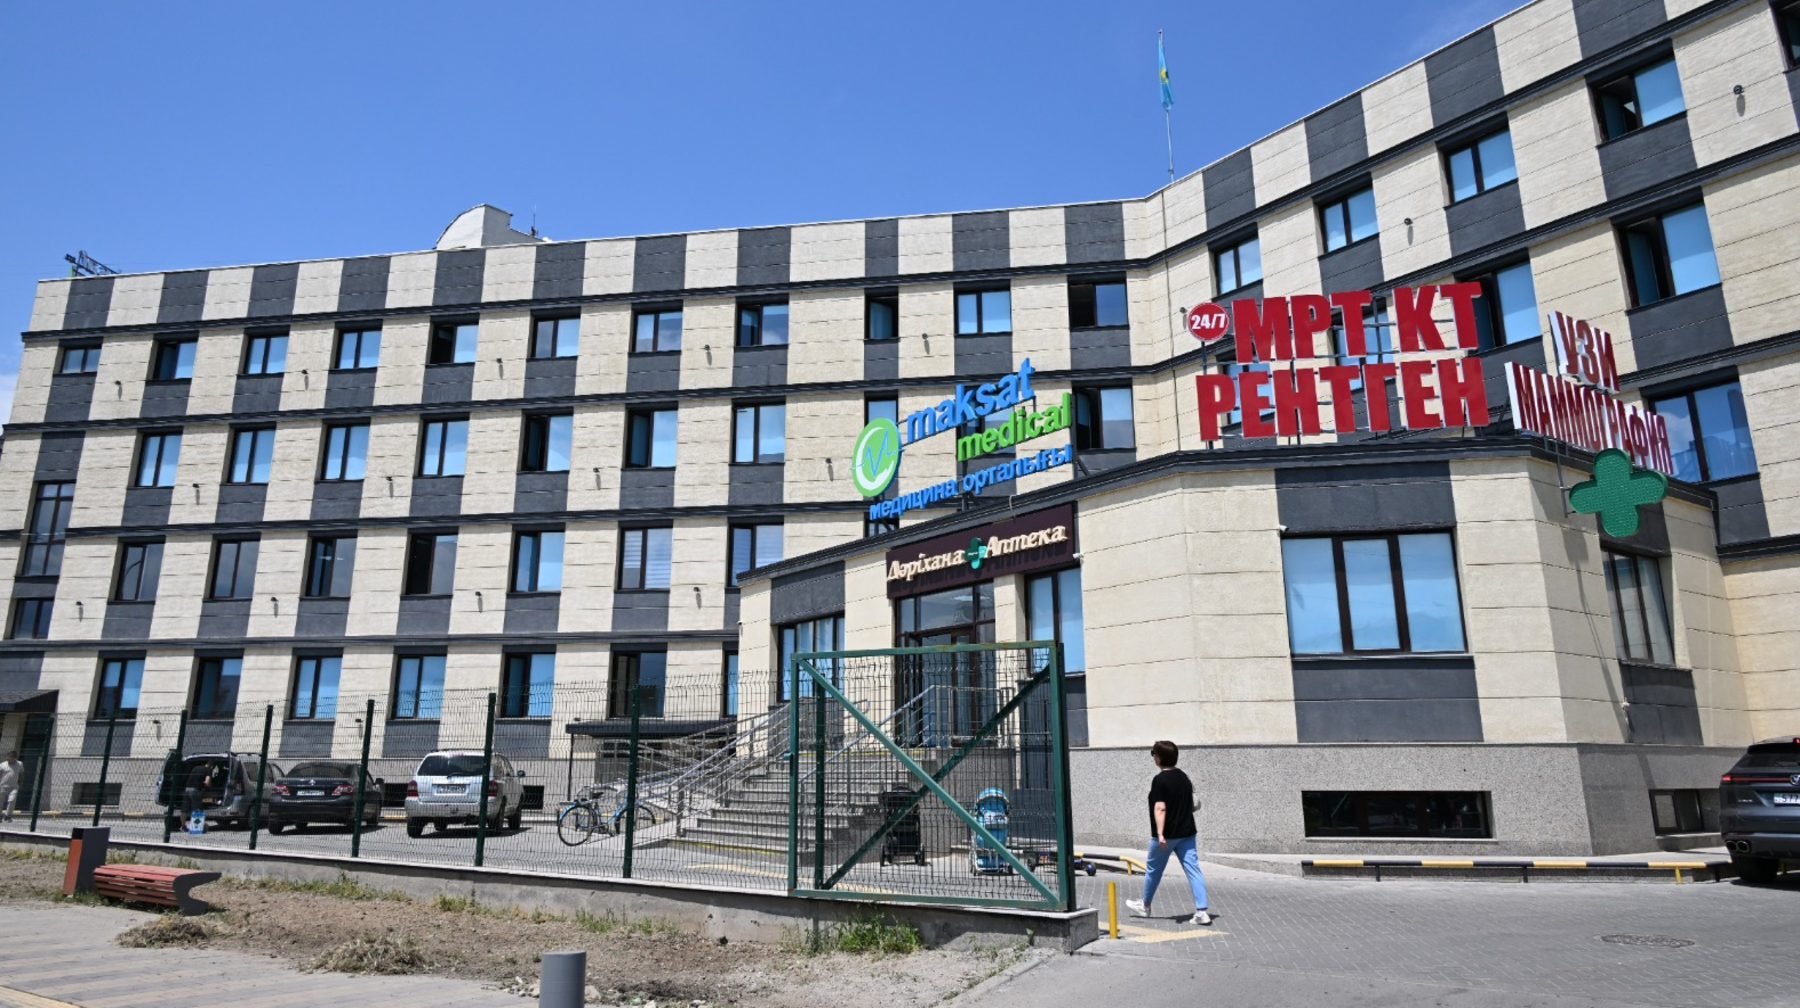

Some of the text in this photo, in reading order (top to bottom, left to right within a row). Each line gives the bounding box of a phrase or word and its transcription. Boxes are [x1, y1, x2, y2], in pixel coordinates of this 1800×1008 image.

[1191, 313, 1226, 330] 24/7
[1232, 282, 1482, 363] МРТ КТ
[1549, 310, 1620, 394] УЗИ
[907, 357, 1035, 443] maksat
[957, 392, 1072, 462] medical
[1196, 357, 1490, 441] РЕНТГЕН
[1504, 361, 1675, 475] МАММОГРАФИЯ
[869, 444, 1073, 521] медицина орталығы
[984, 525, 1068, 558] Аптека
